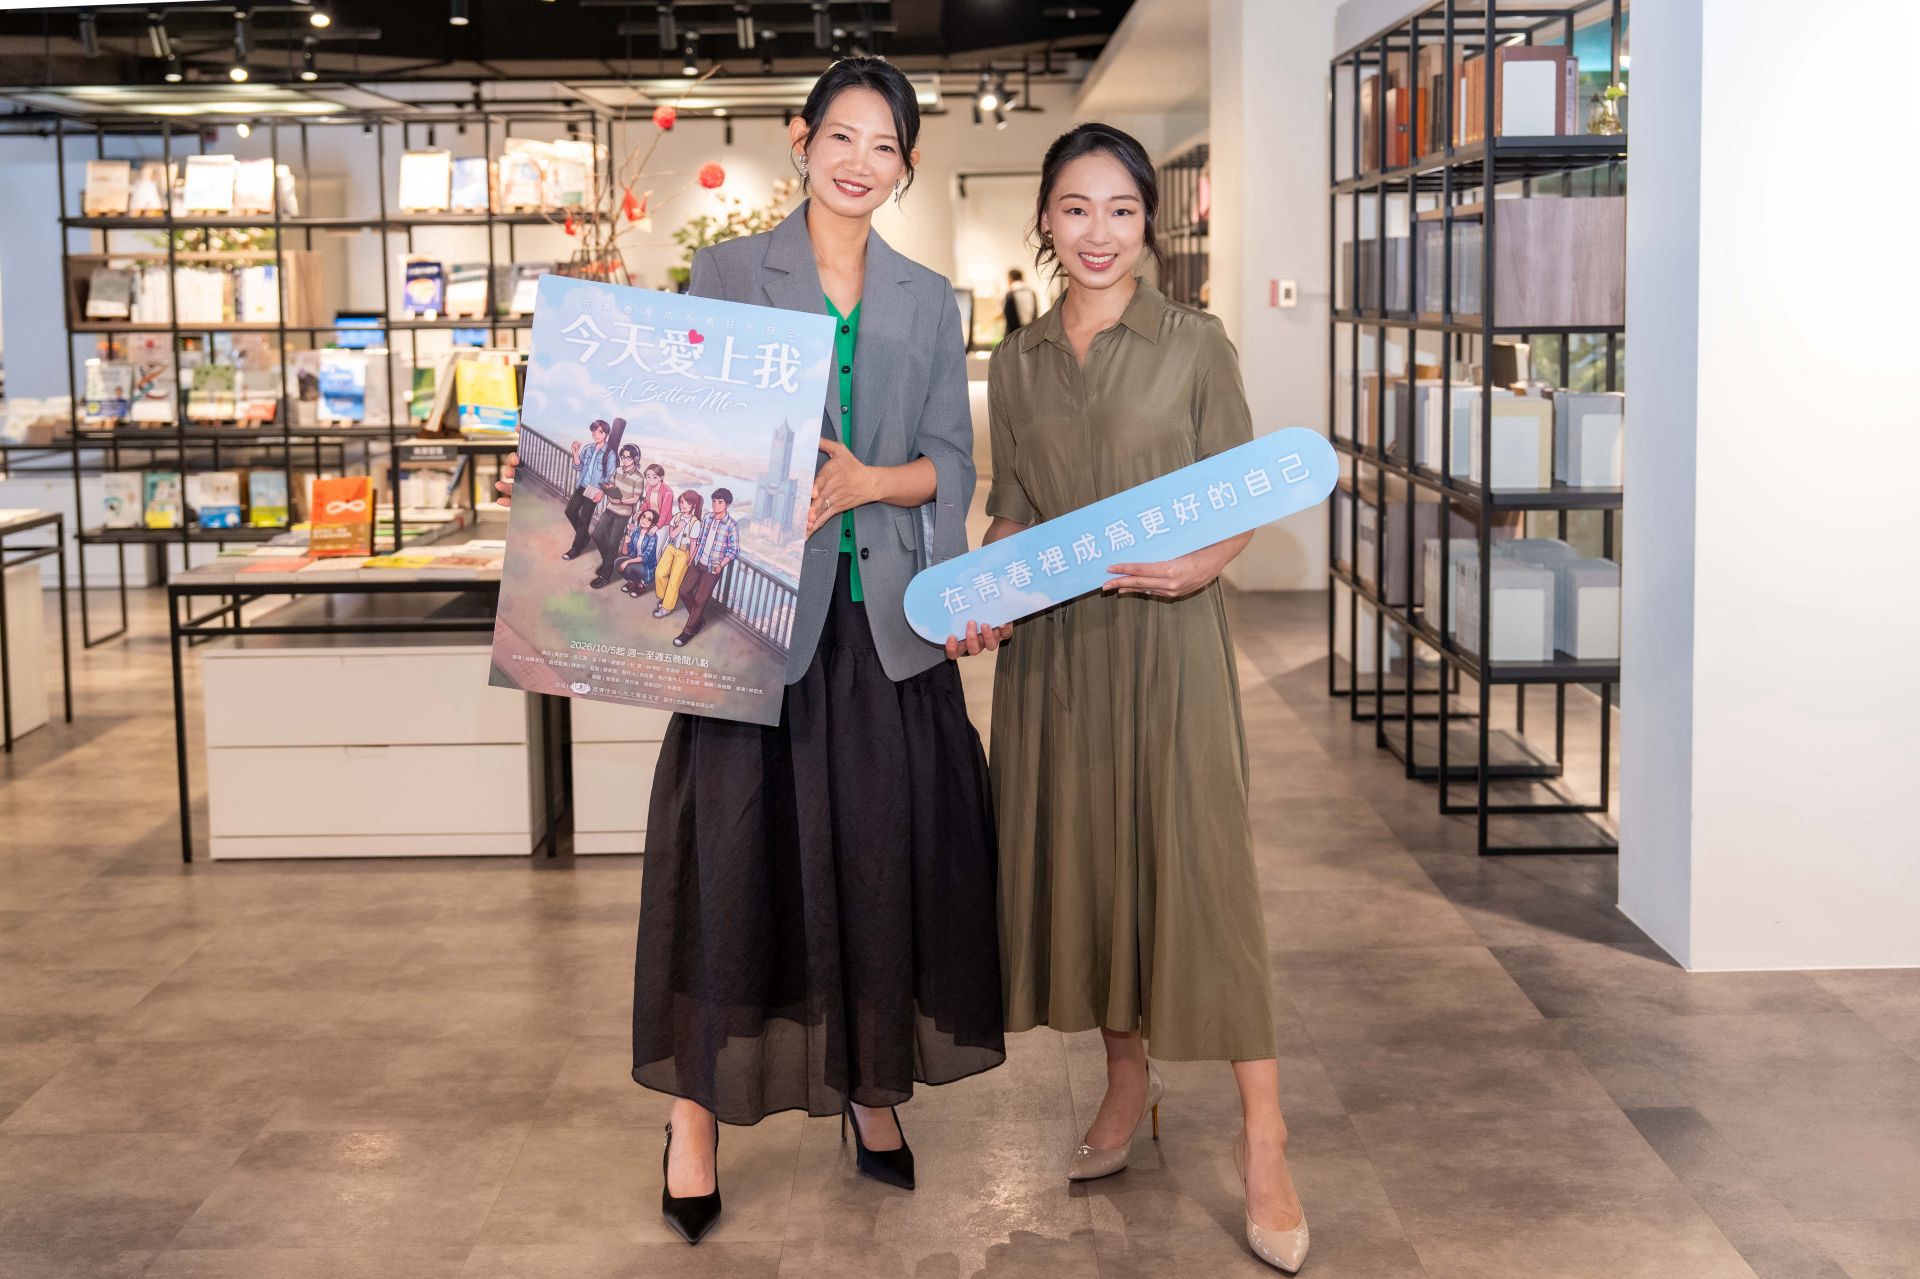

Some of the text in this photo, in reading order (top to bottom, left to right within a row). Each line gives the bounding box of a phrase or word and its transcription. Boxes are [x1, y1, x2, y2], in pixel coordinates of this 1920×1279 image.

[560, 313, 802, 394] 今天愛上我
[600, 376, 748, 416] A Better Me
[569, 640, 626, 656] 2026/10/5起
